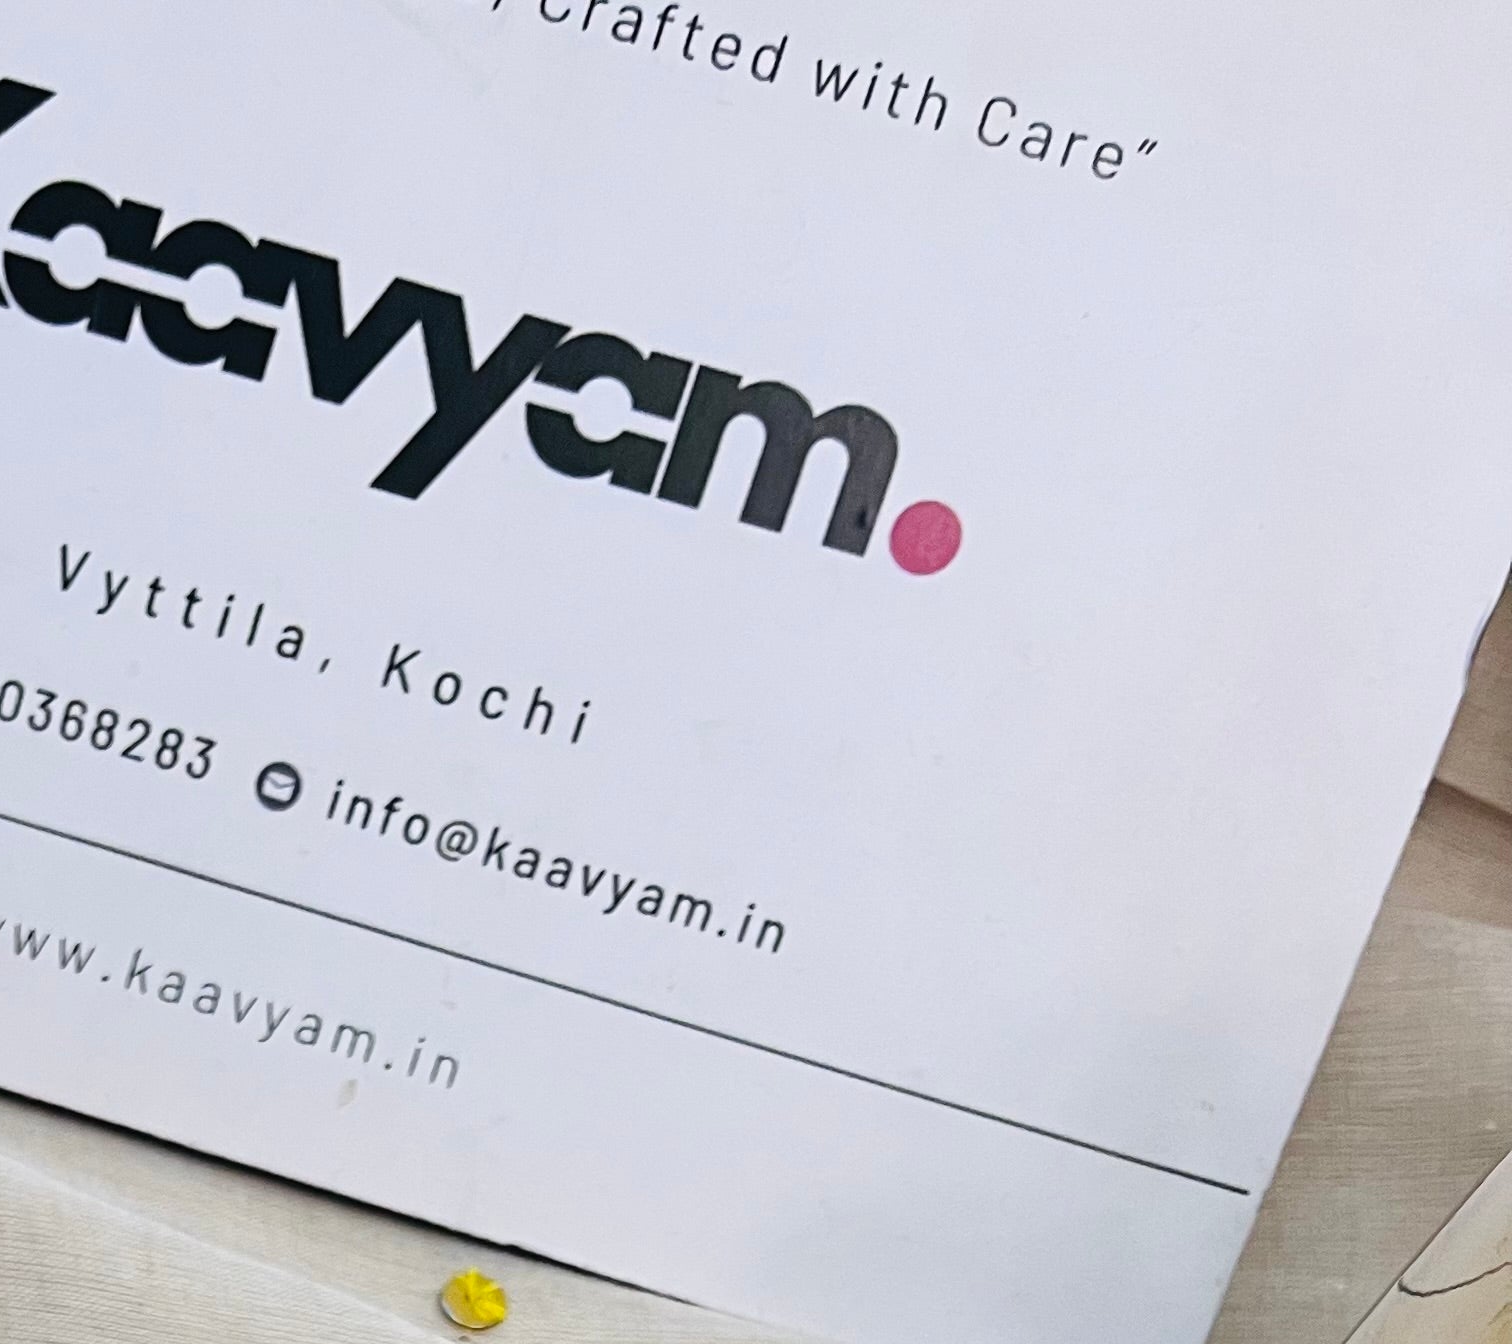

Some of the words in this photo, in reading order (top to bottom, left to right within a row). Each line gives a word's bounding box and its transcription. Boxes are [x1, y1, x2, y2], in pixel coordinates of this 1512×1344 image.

[814, 57, 950, 133] with
[58, 542, 332, 676] Vyttila,
[379, 641, 593, 746] Kochi
[324, 777, 787, 956] info@kaavyam.in
